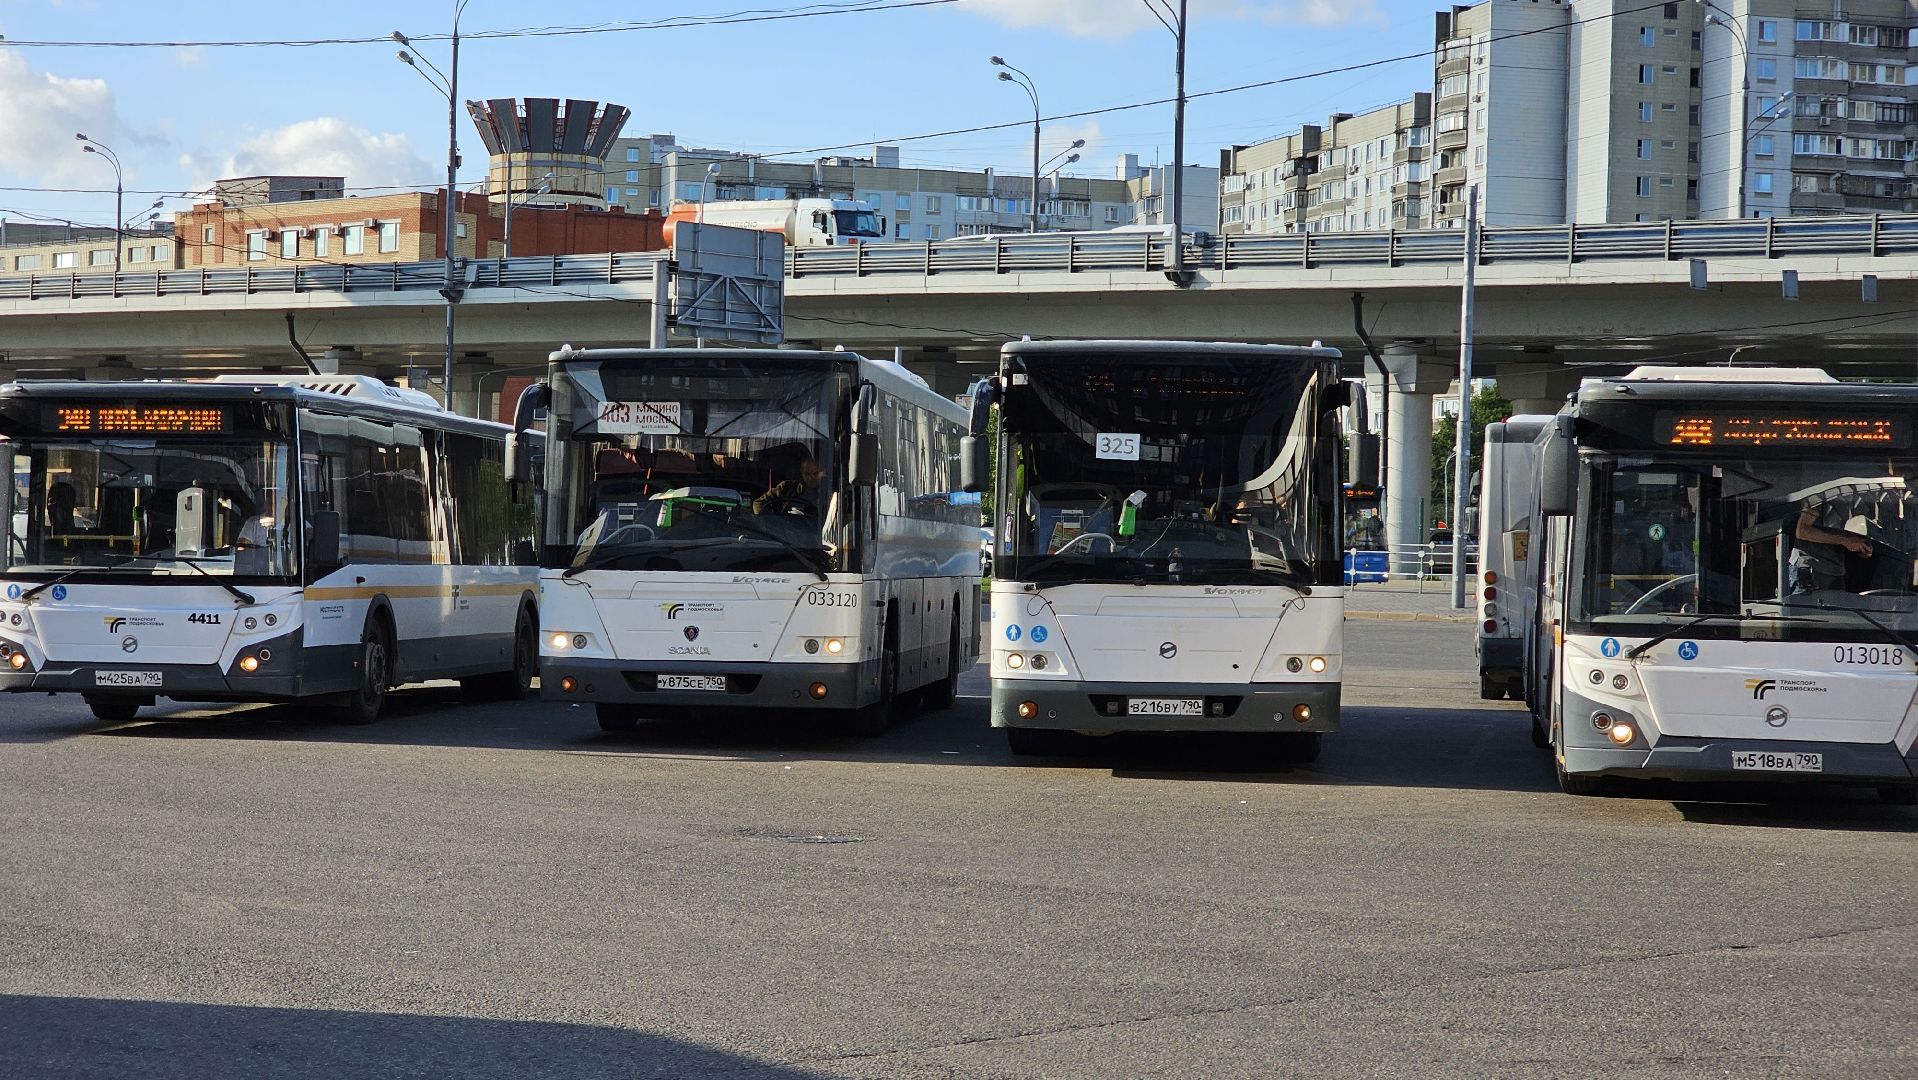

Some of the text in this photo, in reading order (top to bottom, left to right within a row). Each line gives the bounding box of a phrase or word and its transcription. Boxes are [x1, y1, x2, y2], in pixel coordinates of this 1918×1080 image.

[601, 403, 678, 423] 403 МАЛИНО
[636, 415, 678, 424] МОСКВА
[1100, 437, 1134, 454] 325
[807, 590, 858, 608] 033120
[188, 612, 221, 624] 4411
[1833, 645, 1903, 666] 013018
[99, 672, 159, 685] М425ВА 790
[661, 676, 722, 689] У875СЕ 750
[1132, 700, 1199, 713] В216ВУ 790
[1737, 753, 1818, 769] М518ВА 790
